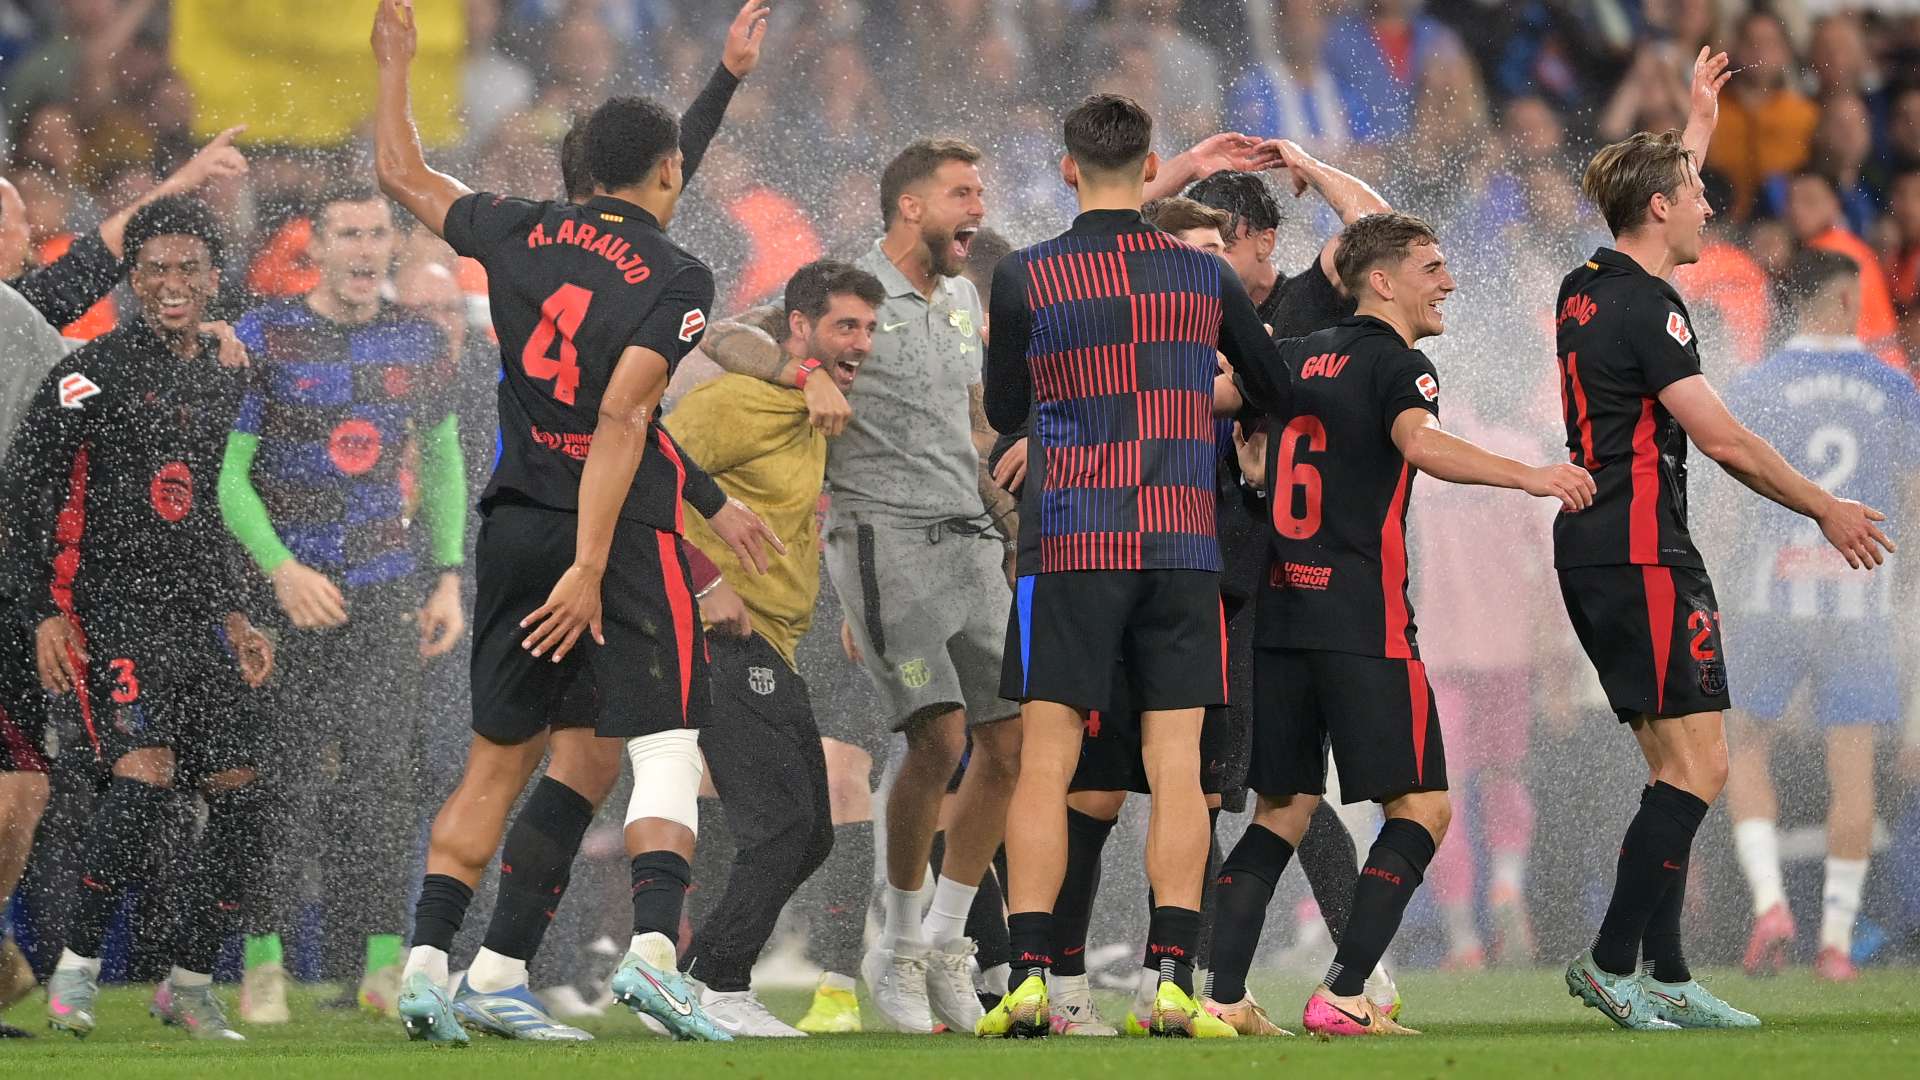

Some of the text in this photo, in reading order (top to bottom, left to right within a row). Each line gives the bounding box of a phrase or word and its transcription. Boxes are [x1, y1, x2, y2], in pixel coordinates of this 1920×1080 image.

[556, 219, 651, 285] ARAUJO
[522, 282, 594, 406] 4
[1301, 353, 1350, 379] GAVI
[1273, 415, 1327, 540] 6
[1807, 425, 1858, 491] 2
[1284, 561, 1332, 577] UNHCR
[109, 657, 139, 704] 3
